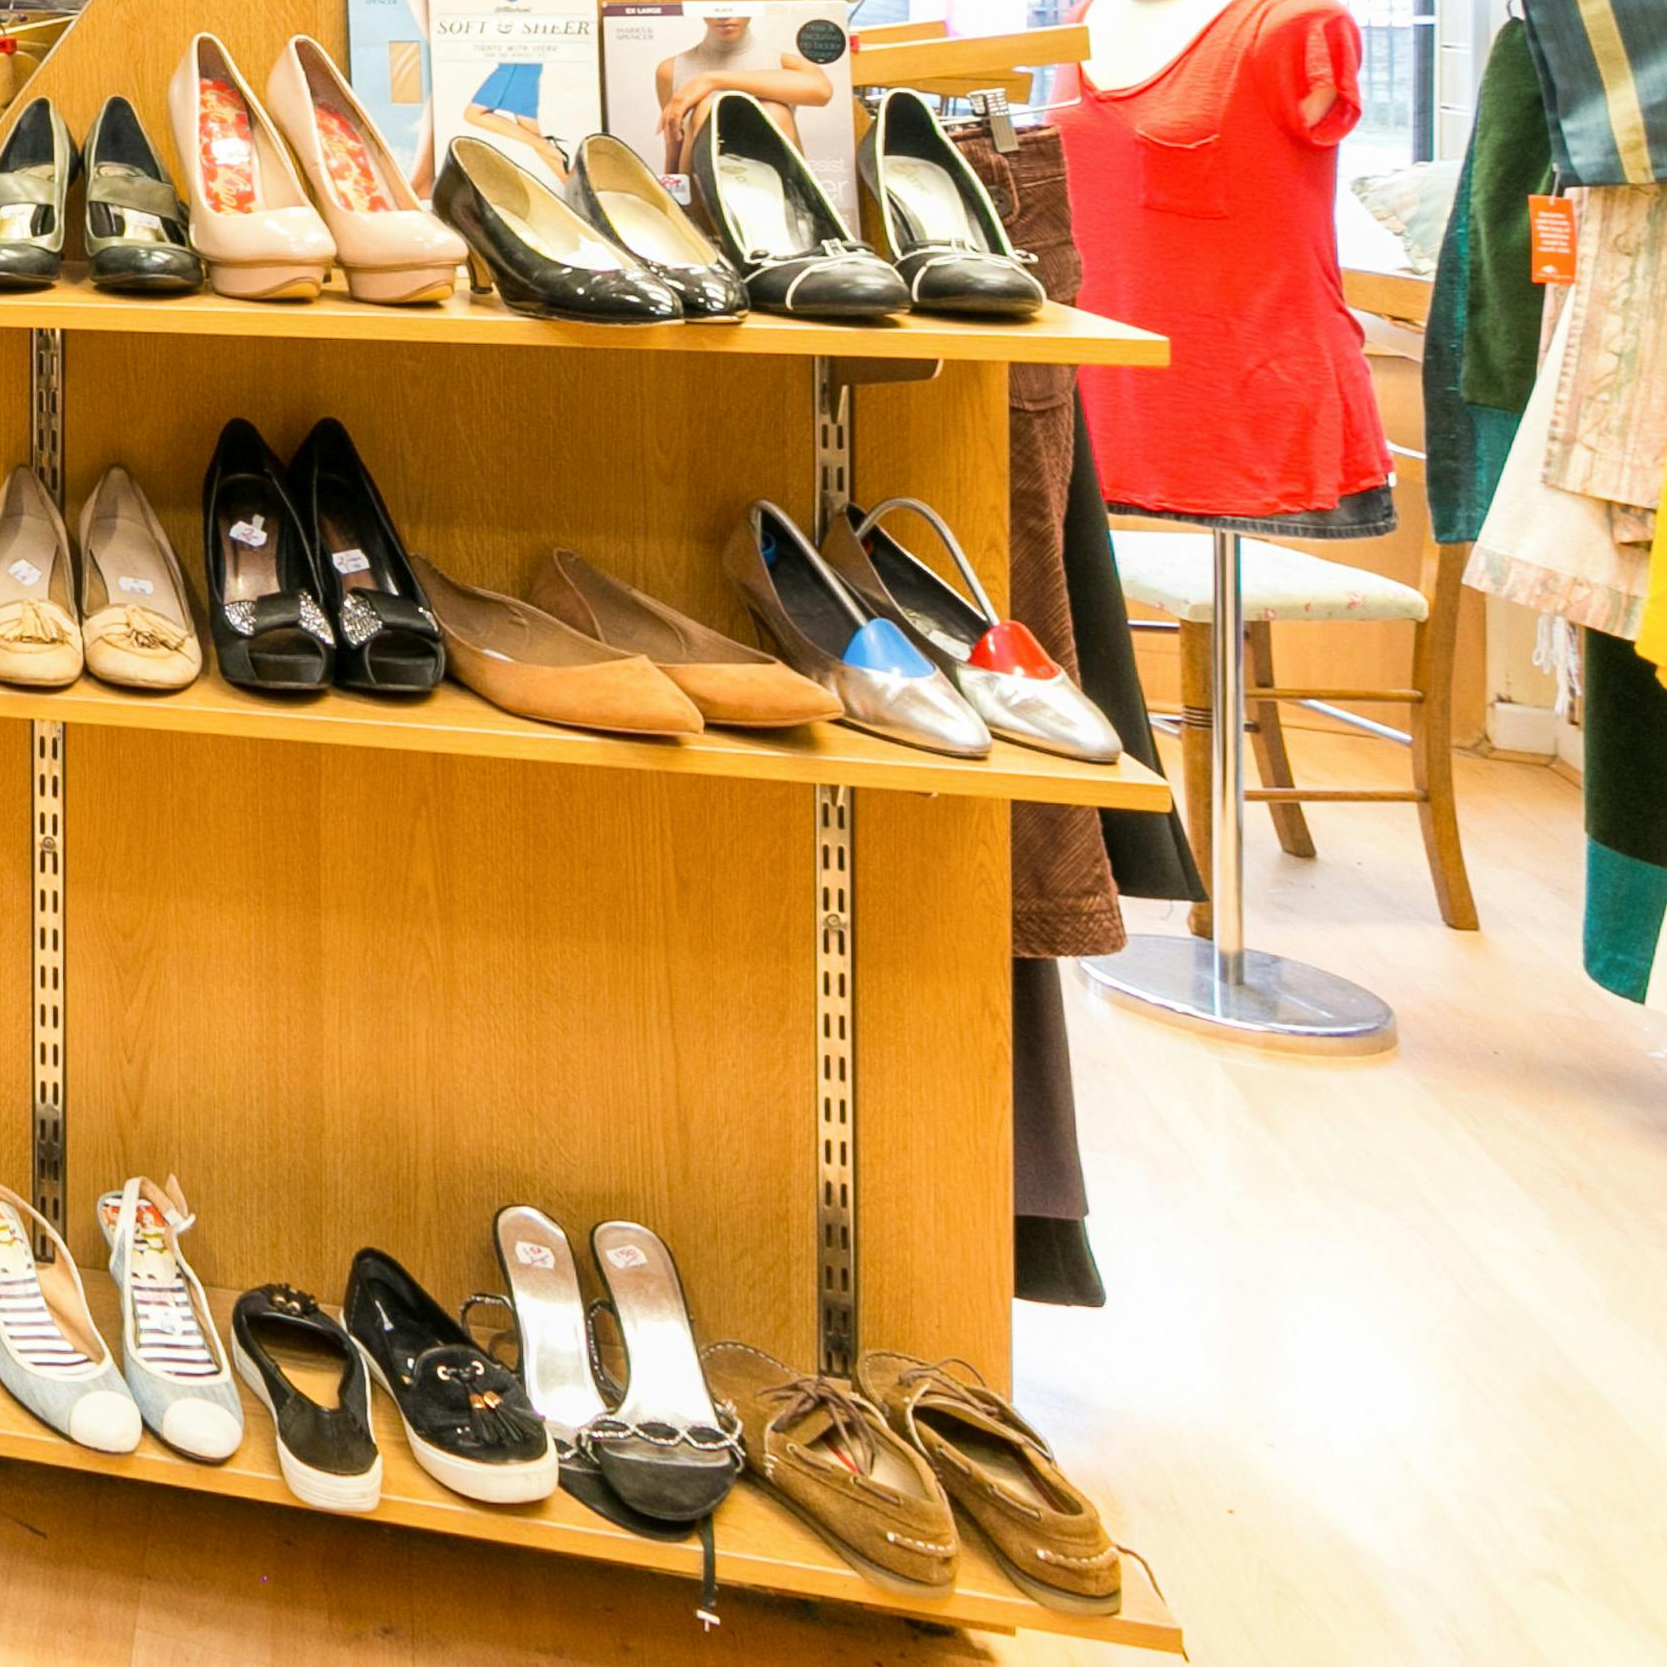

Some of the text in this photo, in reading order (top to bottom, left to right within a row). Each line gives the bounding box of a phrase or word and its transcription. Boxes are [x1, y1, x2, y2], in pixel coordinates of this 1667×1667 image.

[624, 7, 662, 15] EX LARGE
[437, 20, 591, 36] SOFT & SHEER
